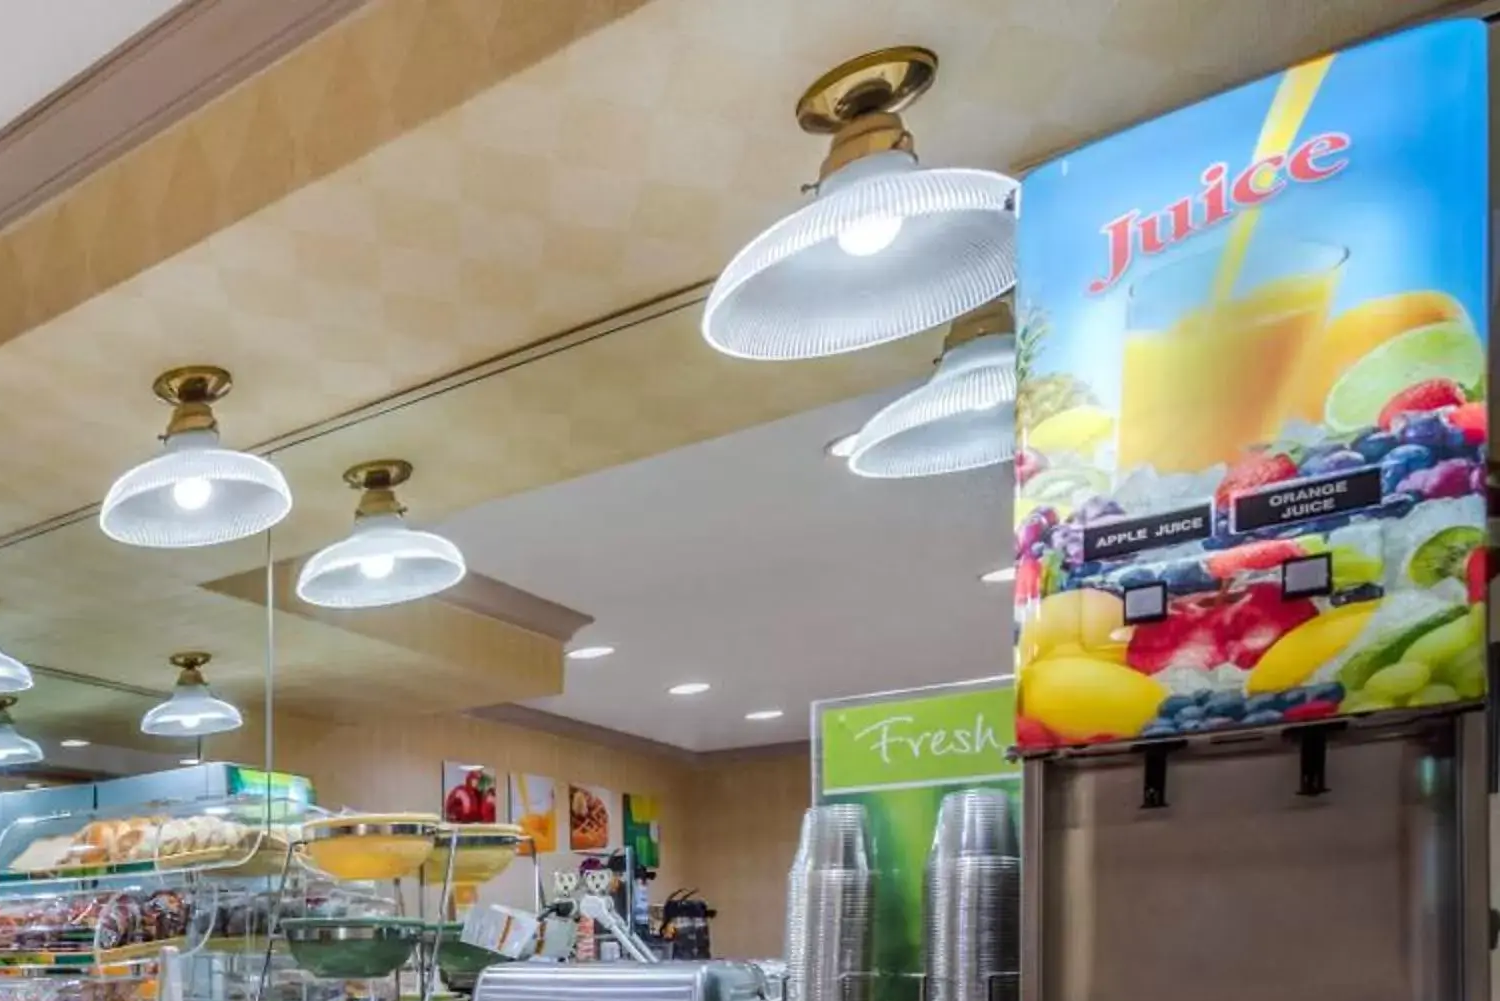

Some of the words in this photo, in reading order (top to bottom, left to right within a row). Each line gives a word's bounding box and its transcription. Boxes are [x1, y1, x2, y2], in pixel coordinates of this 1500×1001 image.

[1086, 132, 1351, 296] Juice
[1268, 479, 1349, 507] ORANGE
[1281, 498, 1336, 519] JUICE
[1095, 528, 1148, 548] APPLE
[1155, 517, 1204, 537] JUICE
[854, 712, 1004, 764] Fresh
